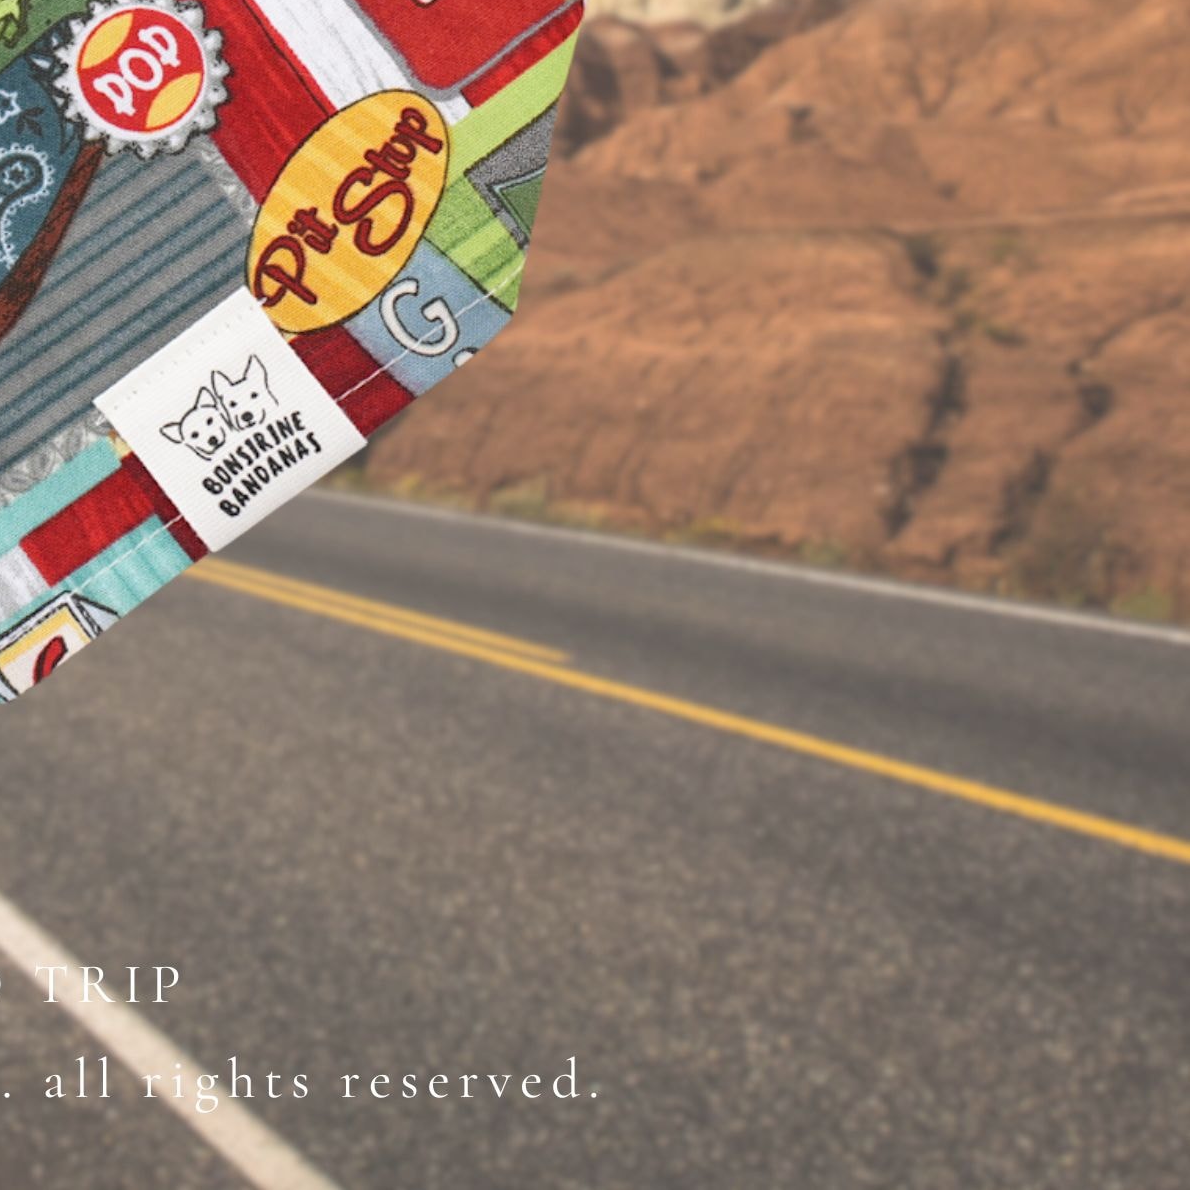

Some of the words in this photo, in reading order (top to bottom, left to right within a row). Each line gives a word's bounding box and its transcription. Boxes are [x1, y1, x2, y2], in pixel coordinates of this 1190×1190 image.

[254, 206, 340, 308] Pit
[332, 107, 444, 256] Stop
[202, 410, 306, 495] BONSIRINE
[219, 432, 322, 517] BANDANAS
